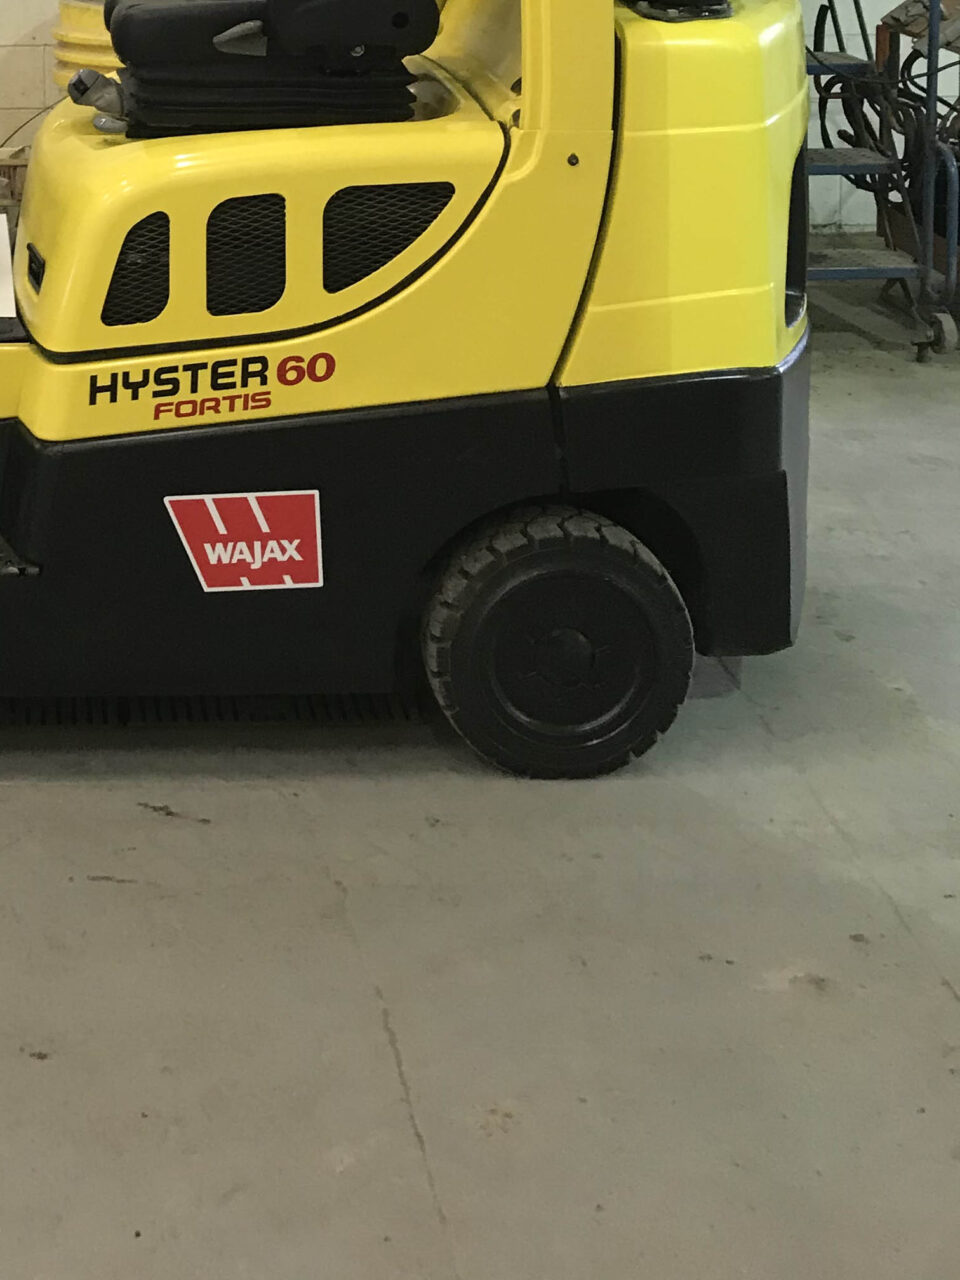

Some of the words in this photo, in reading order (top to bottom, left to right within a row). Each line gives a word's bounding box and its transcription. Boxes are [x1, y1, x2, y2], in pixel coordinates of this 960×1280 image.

[88, 355, 270, 406] HYSTER
[276, 352, 337, 387] 60
[153, 390, 273, 420] FORTIS
[203, 538, 305, 570] WAJAX
